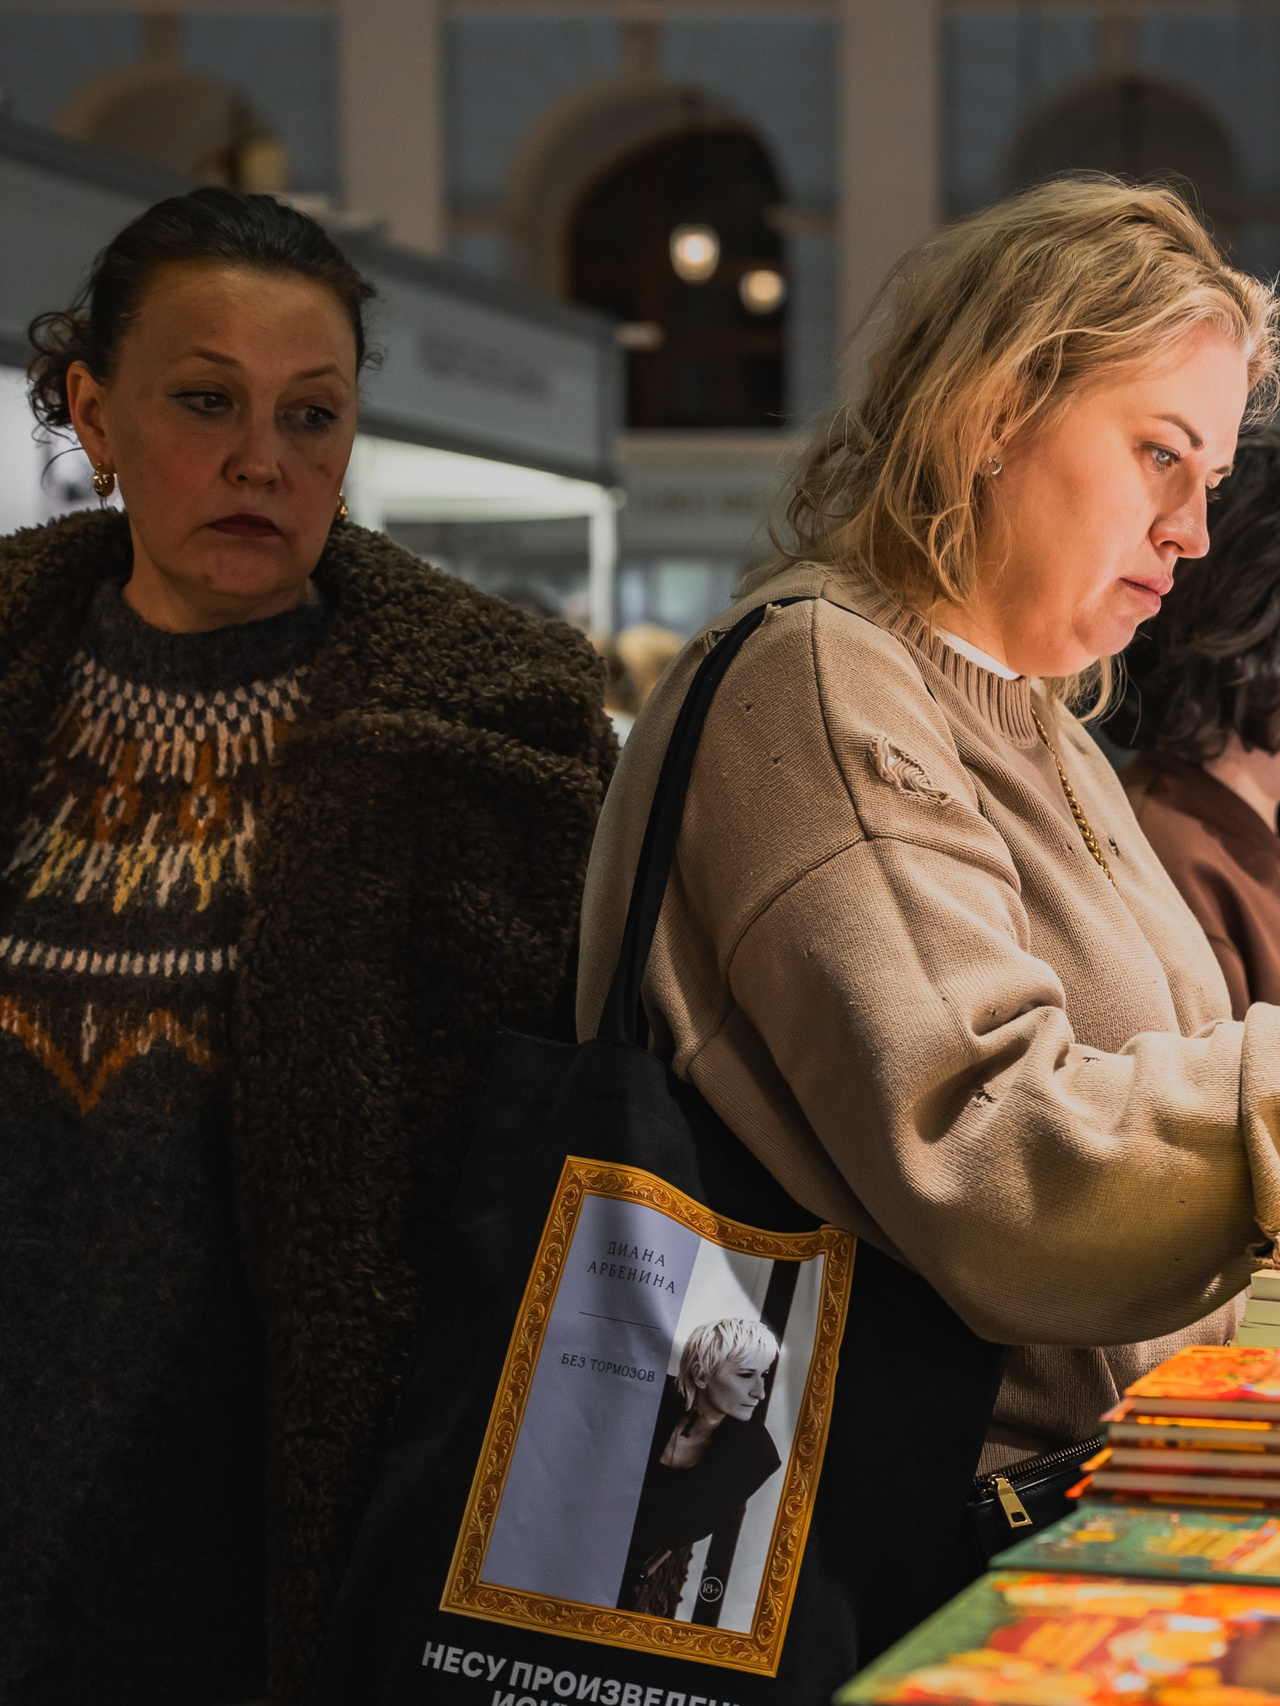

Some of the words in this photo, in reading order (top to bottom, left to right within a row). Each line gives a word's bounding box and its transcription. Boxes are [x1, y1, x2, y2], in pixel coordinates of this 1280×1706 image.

[606, 1241, 666, 1267] ДИАНА
[586, 1261, 676, 1294] АРБЕНИНА
[561, 1353, 586, 1368] БЕЗ
[590, 1359, 656, 1382] ТОРМОЗОВ
[702, 1582, 721, 1595] 18+
[422, 1641, 507, 1682] НЕСУ
